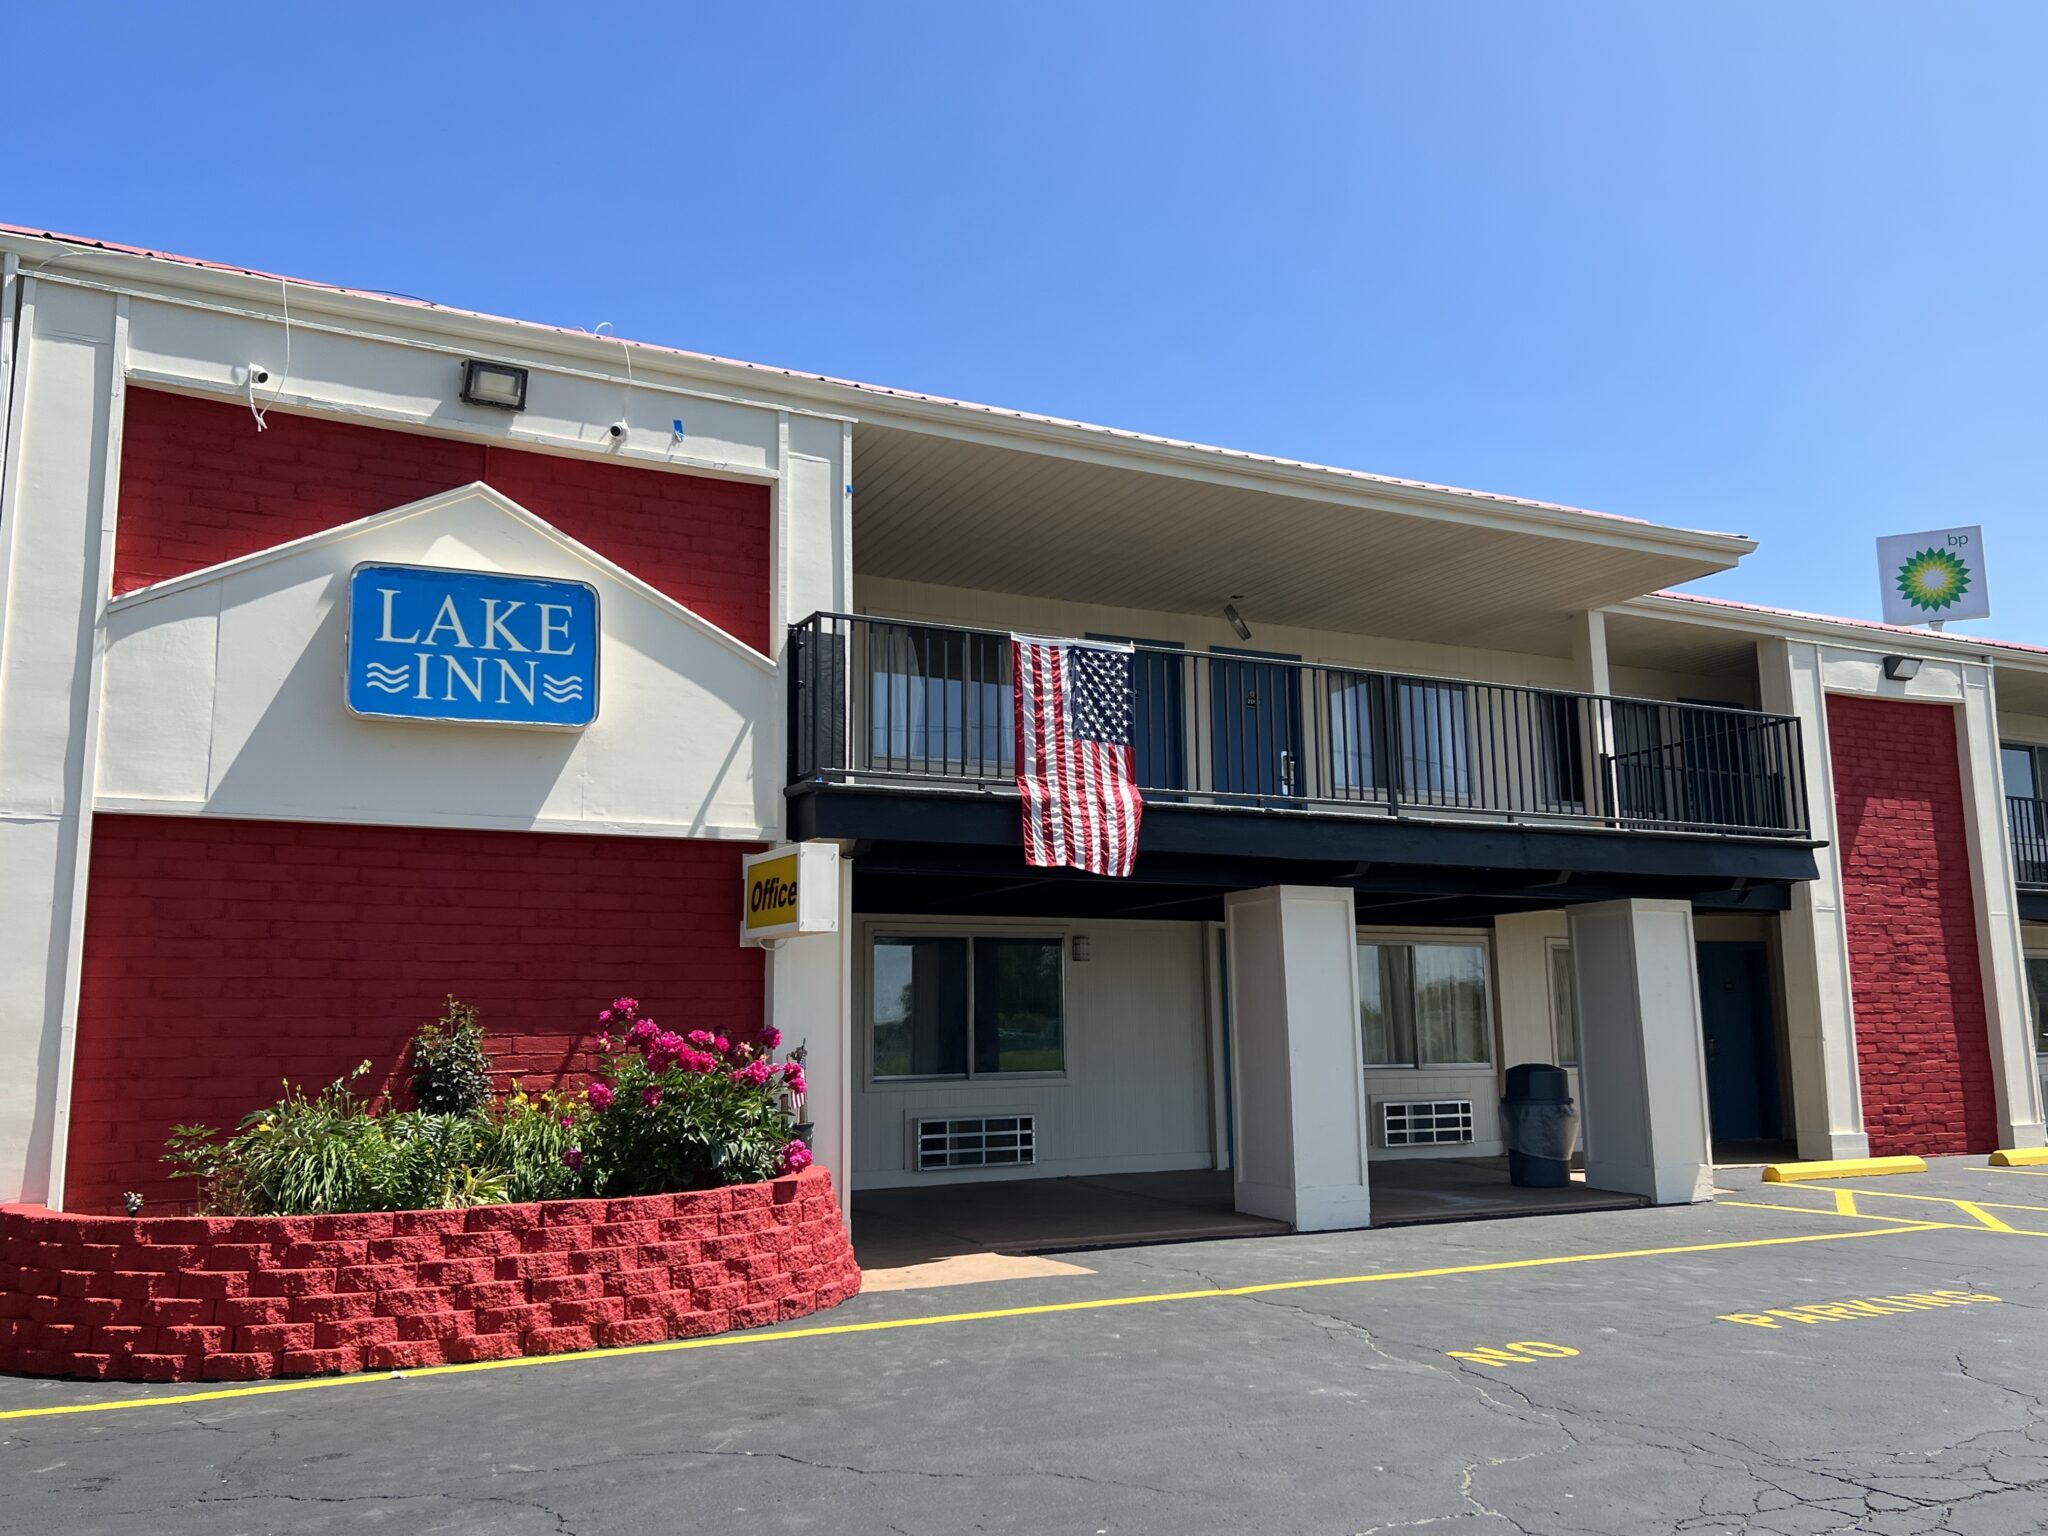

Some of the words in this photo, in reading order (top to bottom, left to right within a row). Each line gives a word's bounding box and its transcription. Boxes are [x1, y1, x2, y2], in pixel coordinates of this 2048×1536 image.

[1947, 534, 1969, 547] bp
[375, 588, 576, 656] LAKE
[412, 652, 540, 706] INN
[751, 877, 798, 912] Office
[1445, 1341, 1581, 1368] NO
[1715, 1290, 2002, 1329] PARKING
